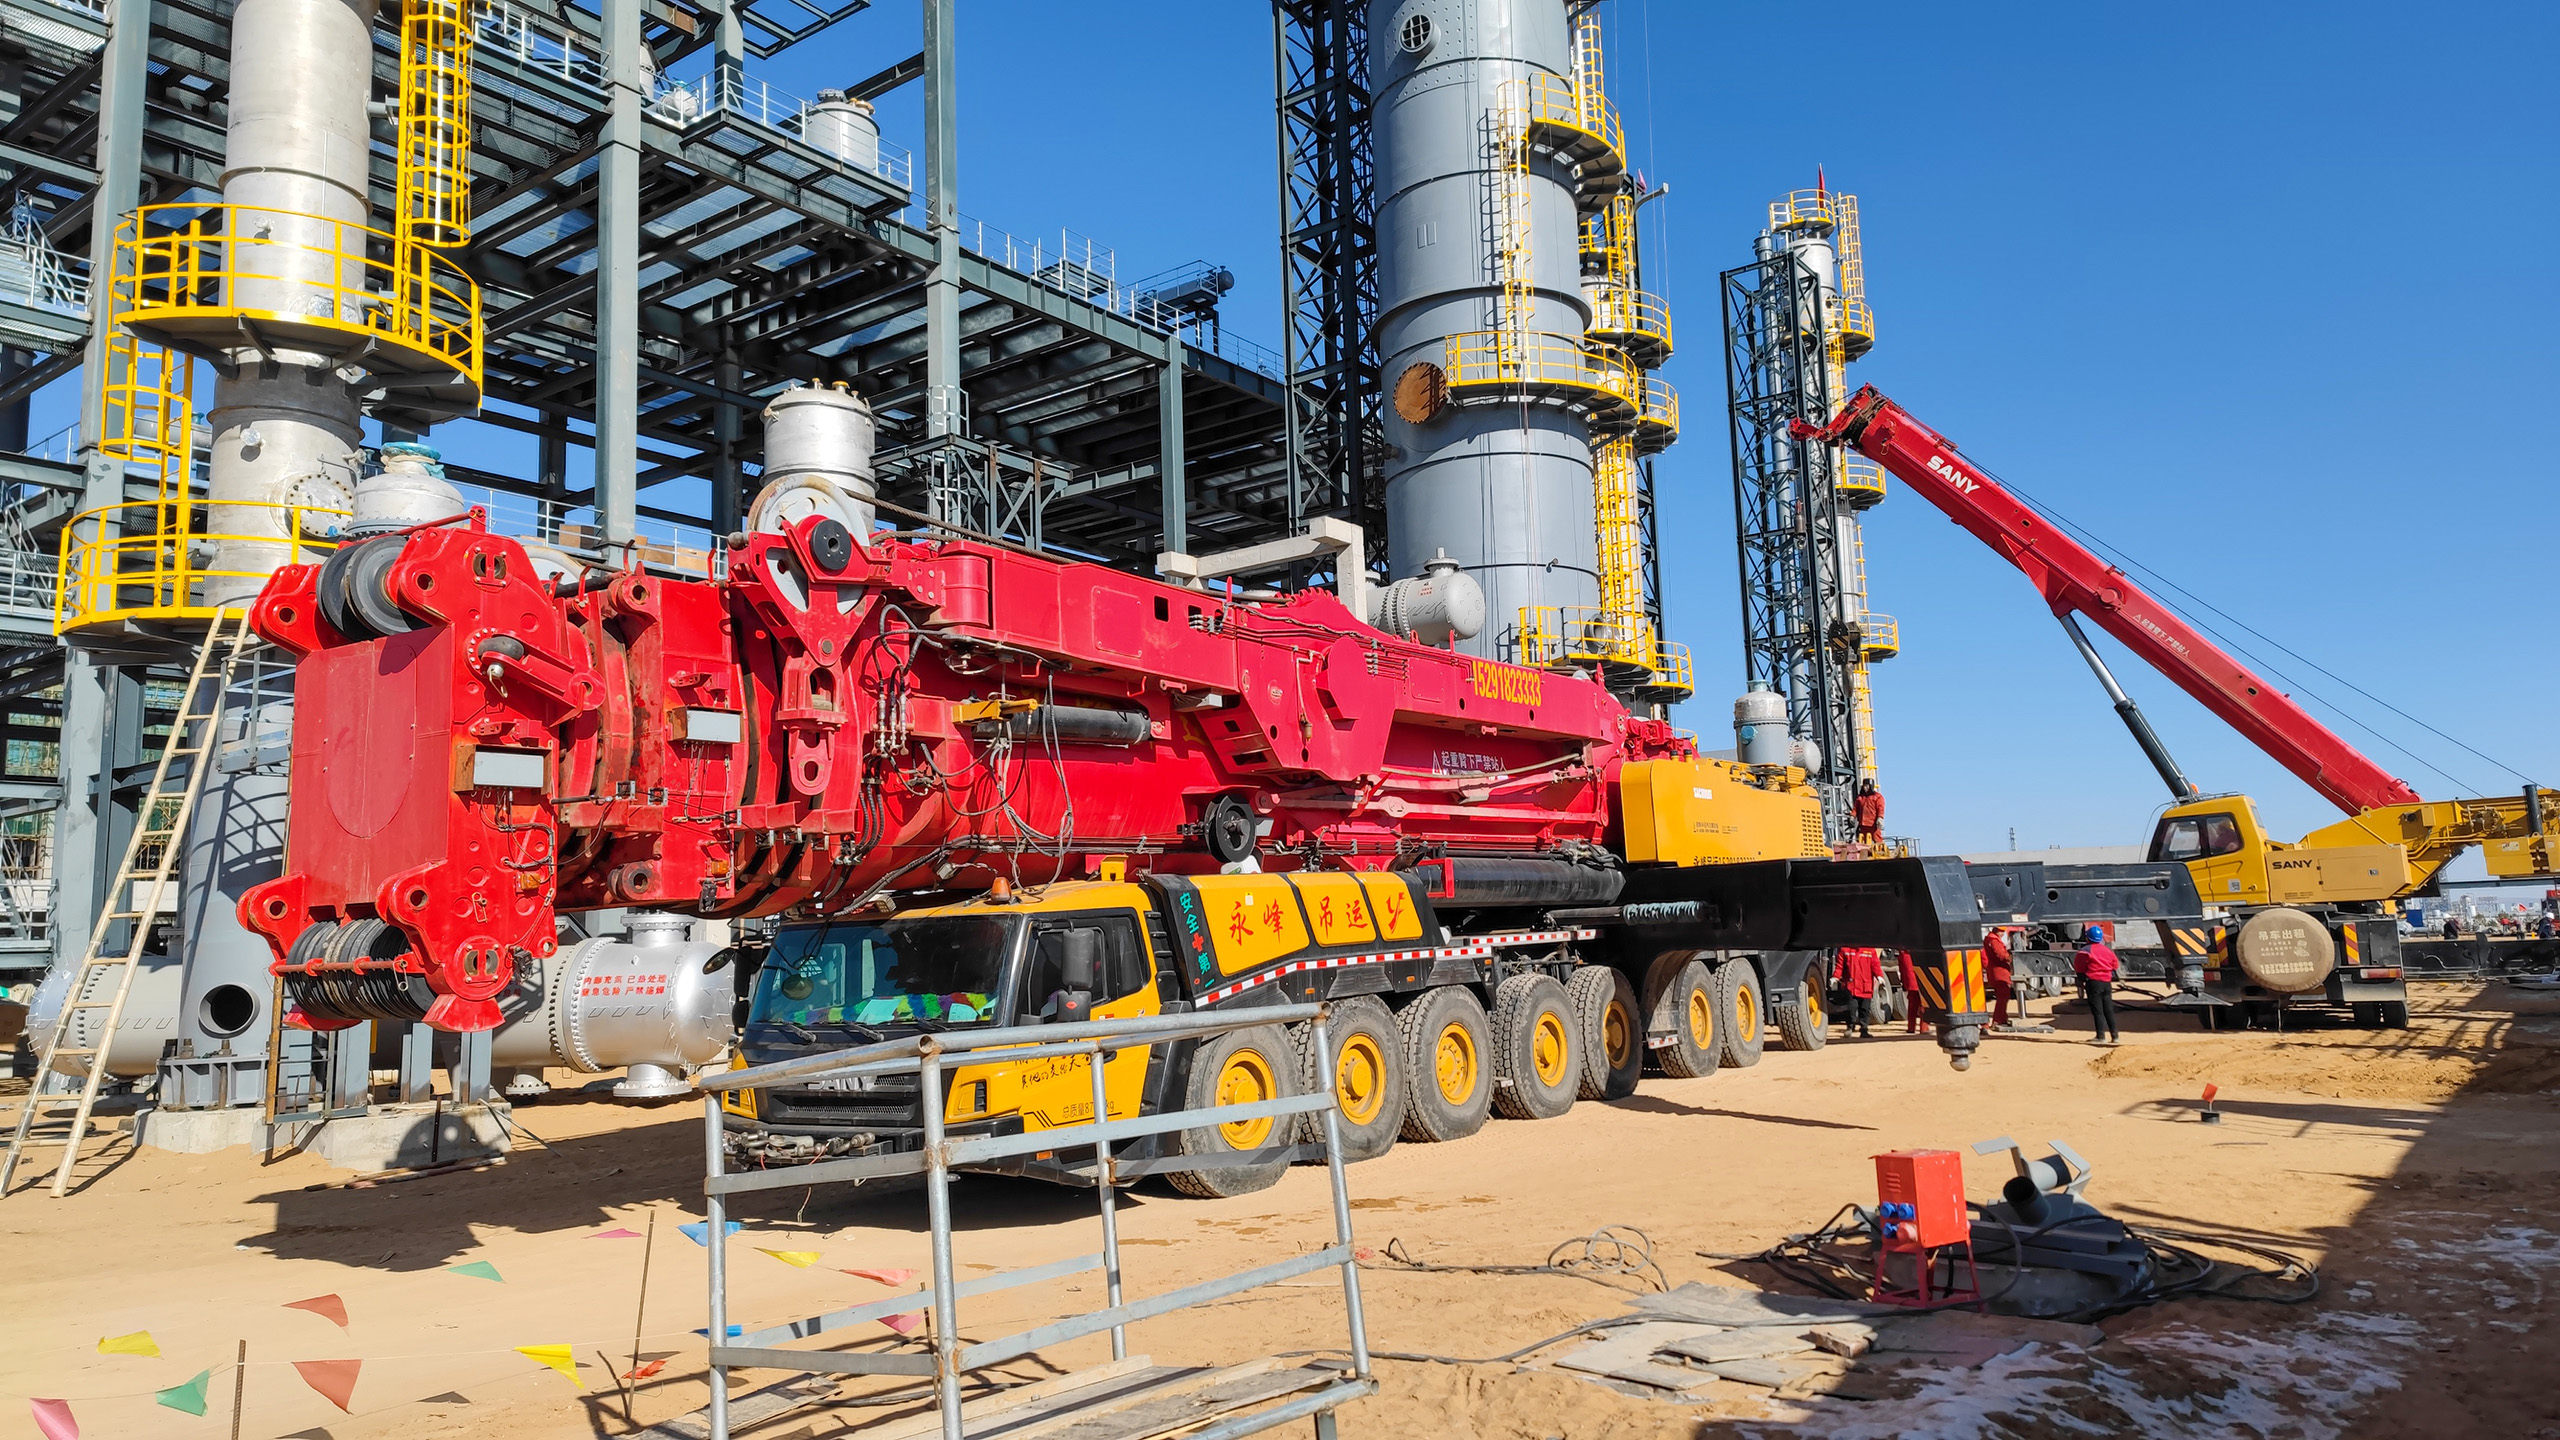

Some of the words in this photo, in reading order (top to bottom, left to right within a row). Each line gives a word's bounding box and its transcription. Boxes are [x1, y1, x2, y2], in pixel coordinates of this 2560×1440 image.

[1926, 455, 1980, 494] SANY
[1472, 660, 1541, 707] 15291823333
[1441, 750, 1507, 772] 起重臂下严禁站人
[2272, 859, 2313, 870] SANY
[2258, 928, 2306, 941] 吊车出租
[627, 974, 667, 984] 已热处理
